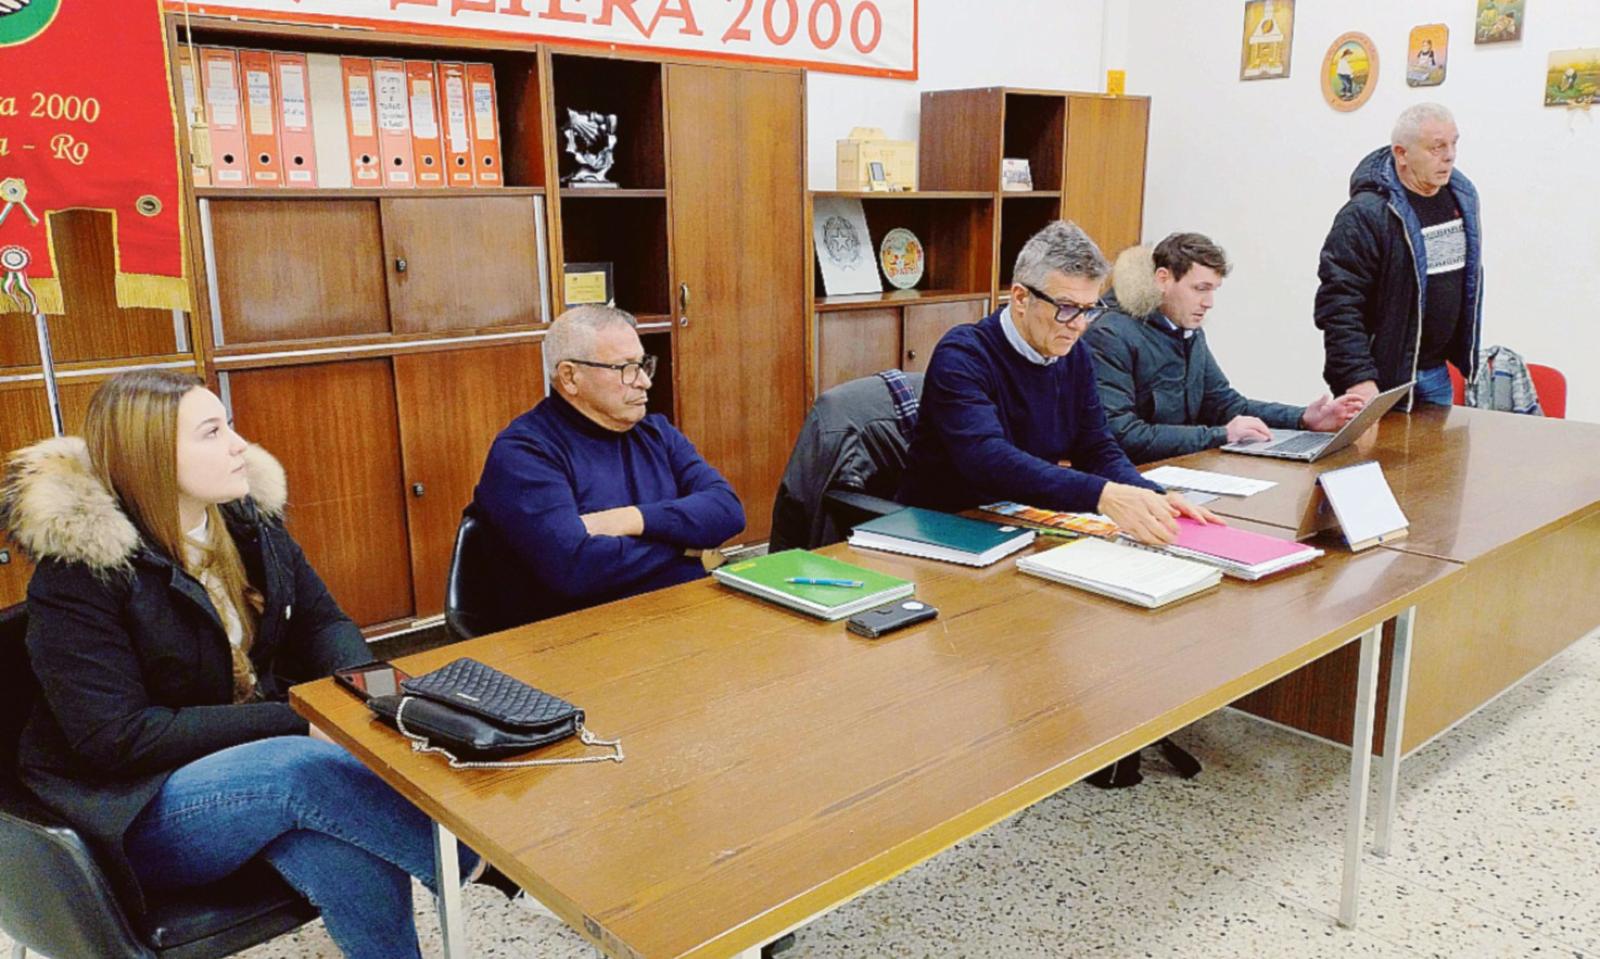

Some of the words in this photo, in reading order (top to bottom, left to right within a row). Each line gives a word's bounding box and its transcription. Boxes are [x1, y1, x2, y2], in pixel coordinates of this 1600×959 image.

[721, 0, 882, 54] 2000
[30, 91, 100, 123] 2000
[50, 133, 89, 166] Ro
